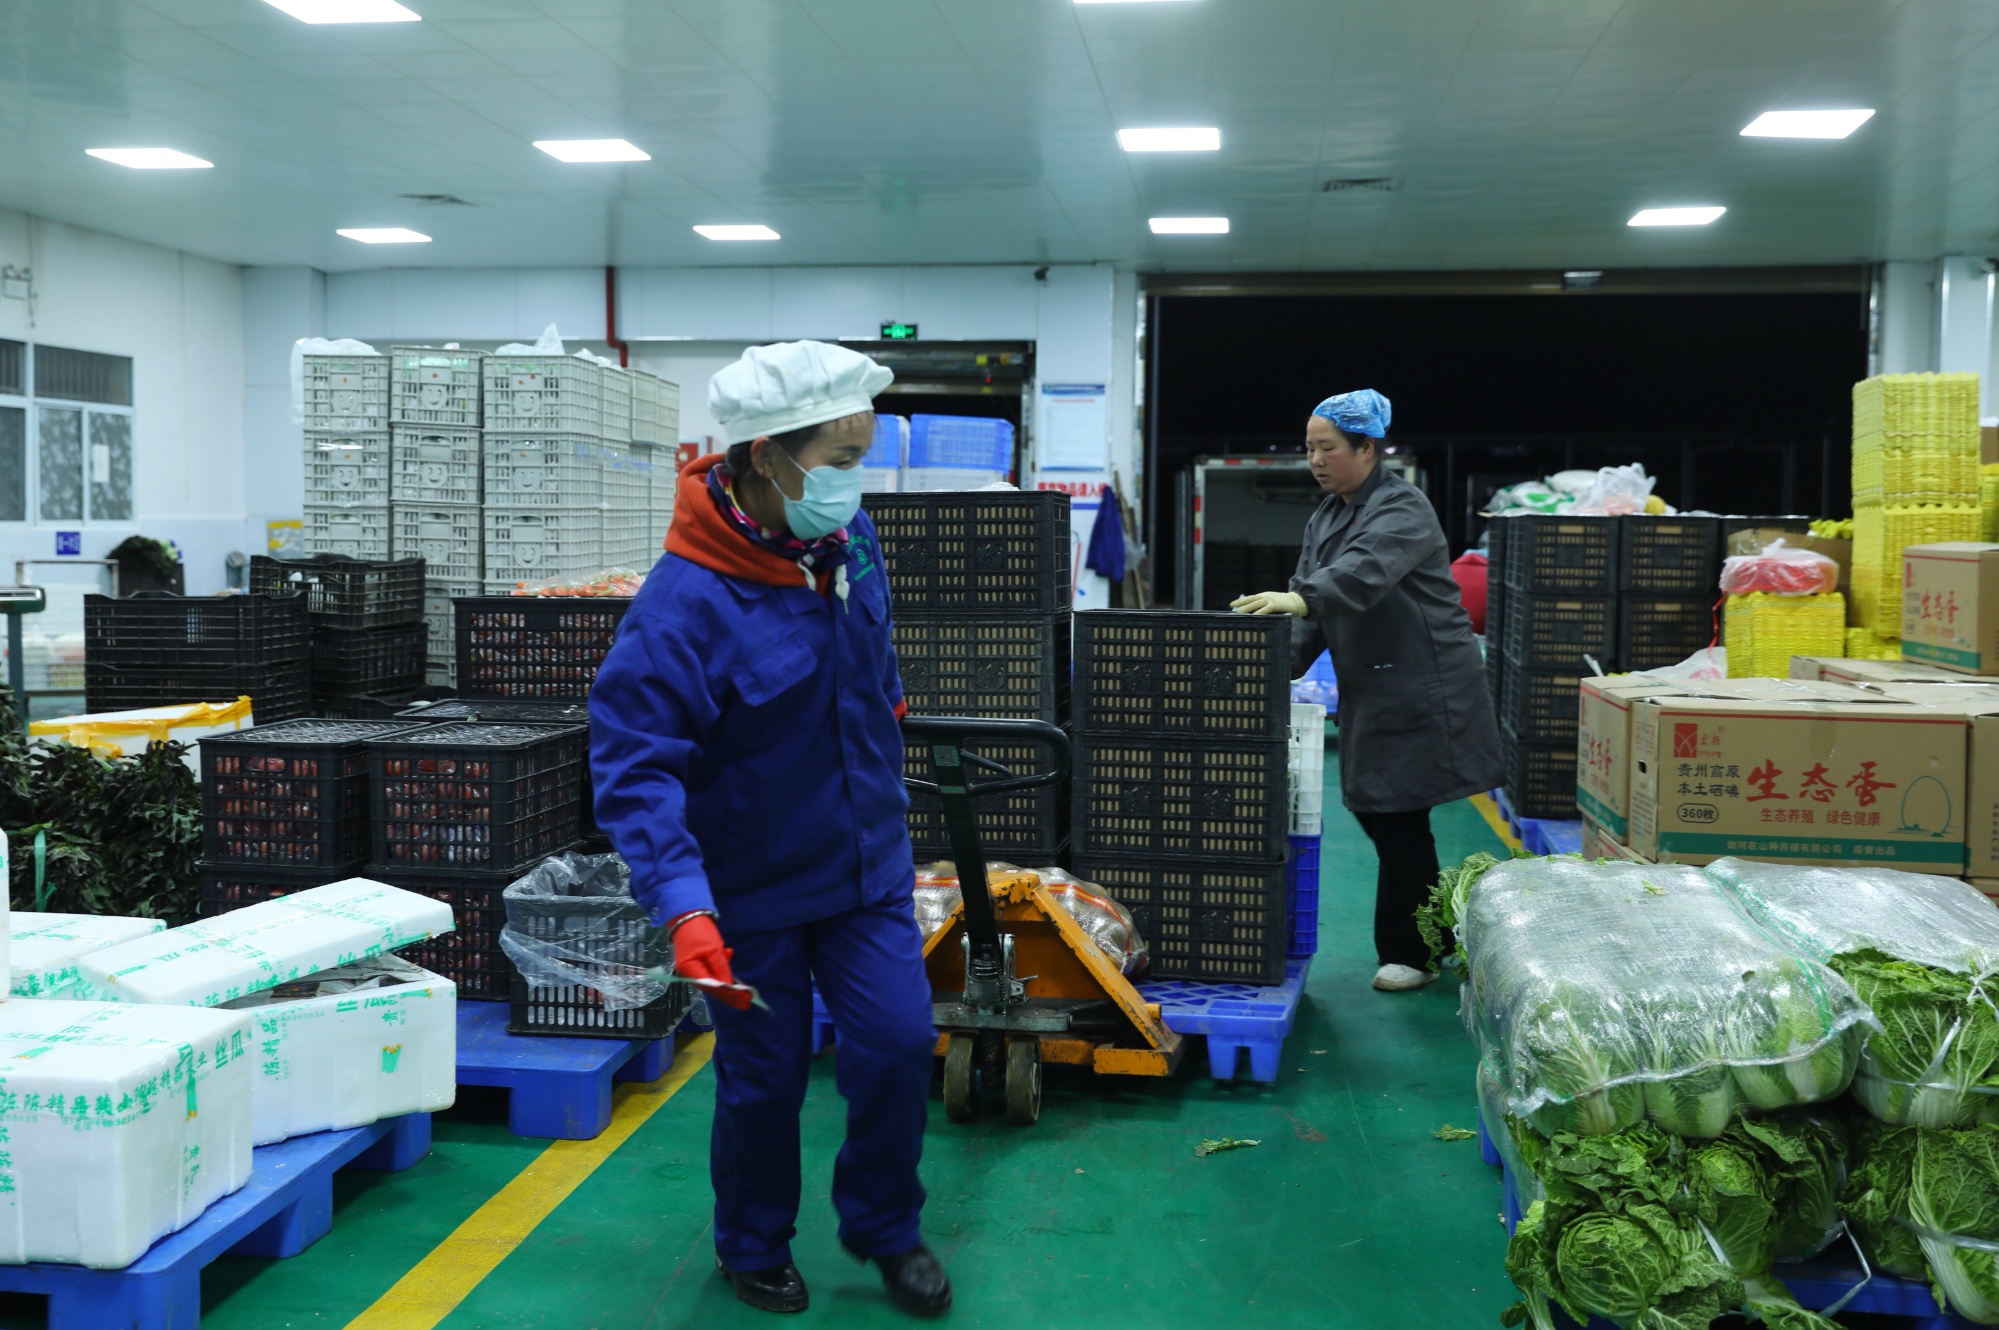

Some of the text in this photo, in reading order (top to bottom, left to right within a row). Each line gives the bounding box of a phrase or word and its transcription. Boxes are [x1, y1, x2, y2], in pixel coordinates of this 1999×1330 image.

[1677, 763, 1740, 778] 贵州高原
[1677, 781, 1740, 798] 本土硒碘
[1746, 758, 1897, 806] 生态蛋
[1681, 808, 1715, 820] 360枚
[1760, 808, 1881, 826] 生态养殖 绿色健康
[1853, 845, 1896, 856] 荣誉出品
